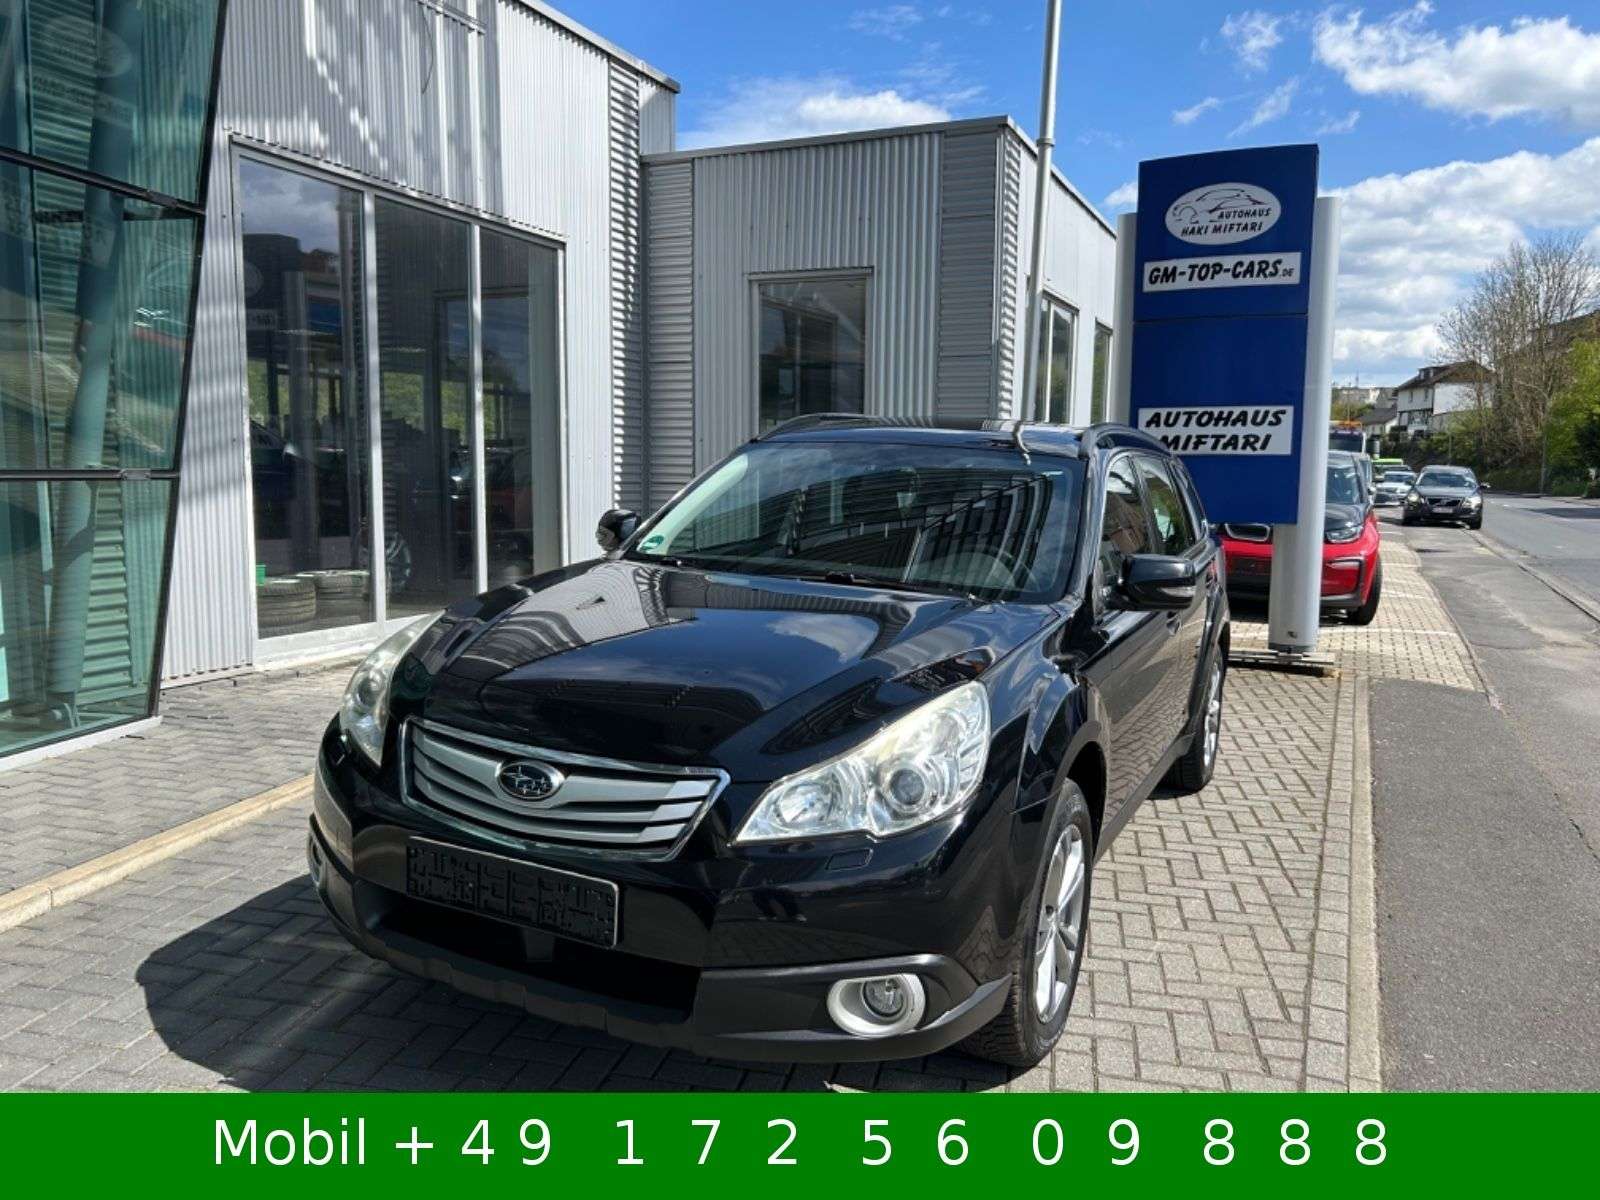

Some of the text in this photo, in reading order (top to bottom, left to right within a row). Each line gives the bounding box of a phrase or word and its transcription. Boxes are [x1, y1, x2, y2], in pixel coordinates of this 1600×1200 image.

[1217, 207, 1272, 220] AUTOHAUS
[1180, 221, 1263, 237] HAKI MIFTARI
[1145, 409, 1287, 428] AUTOHAUS
[1160, 433, 1273, 452] MIFTARI
